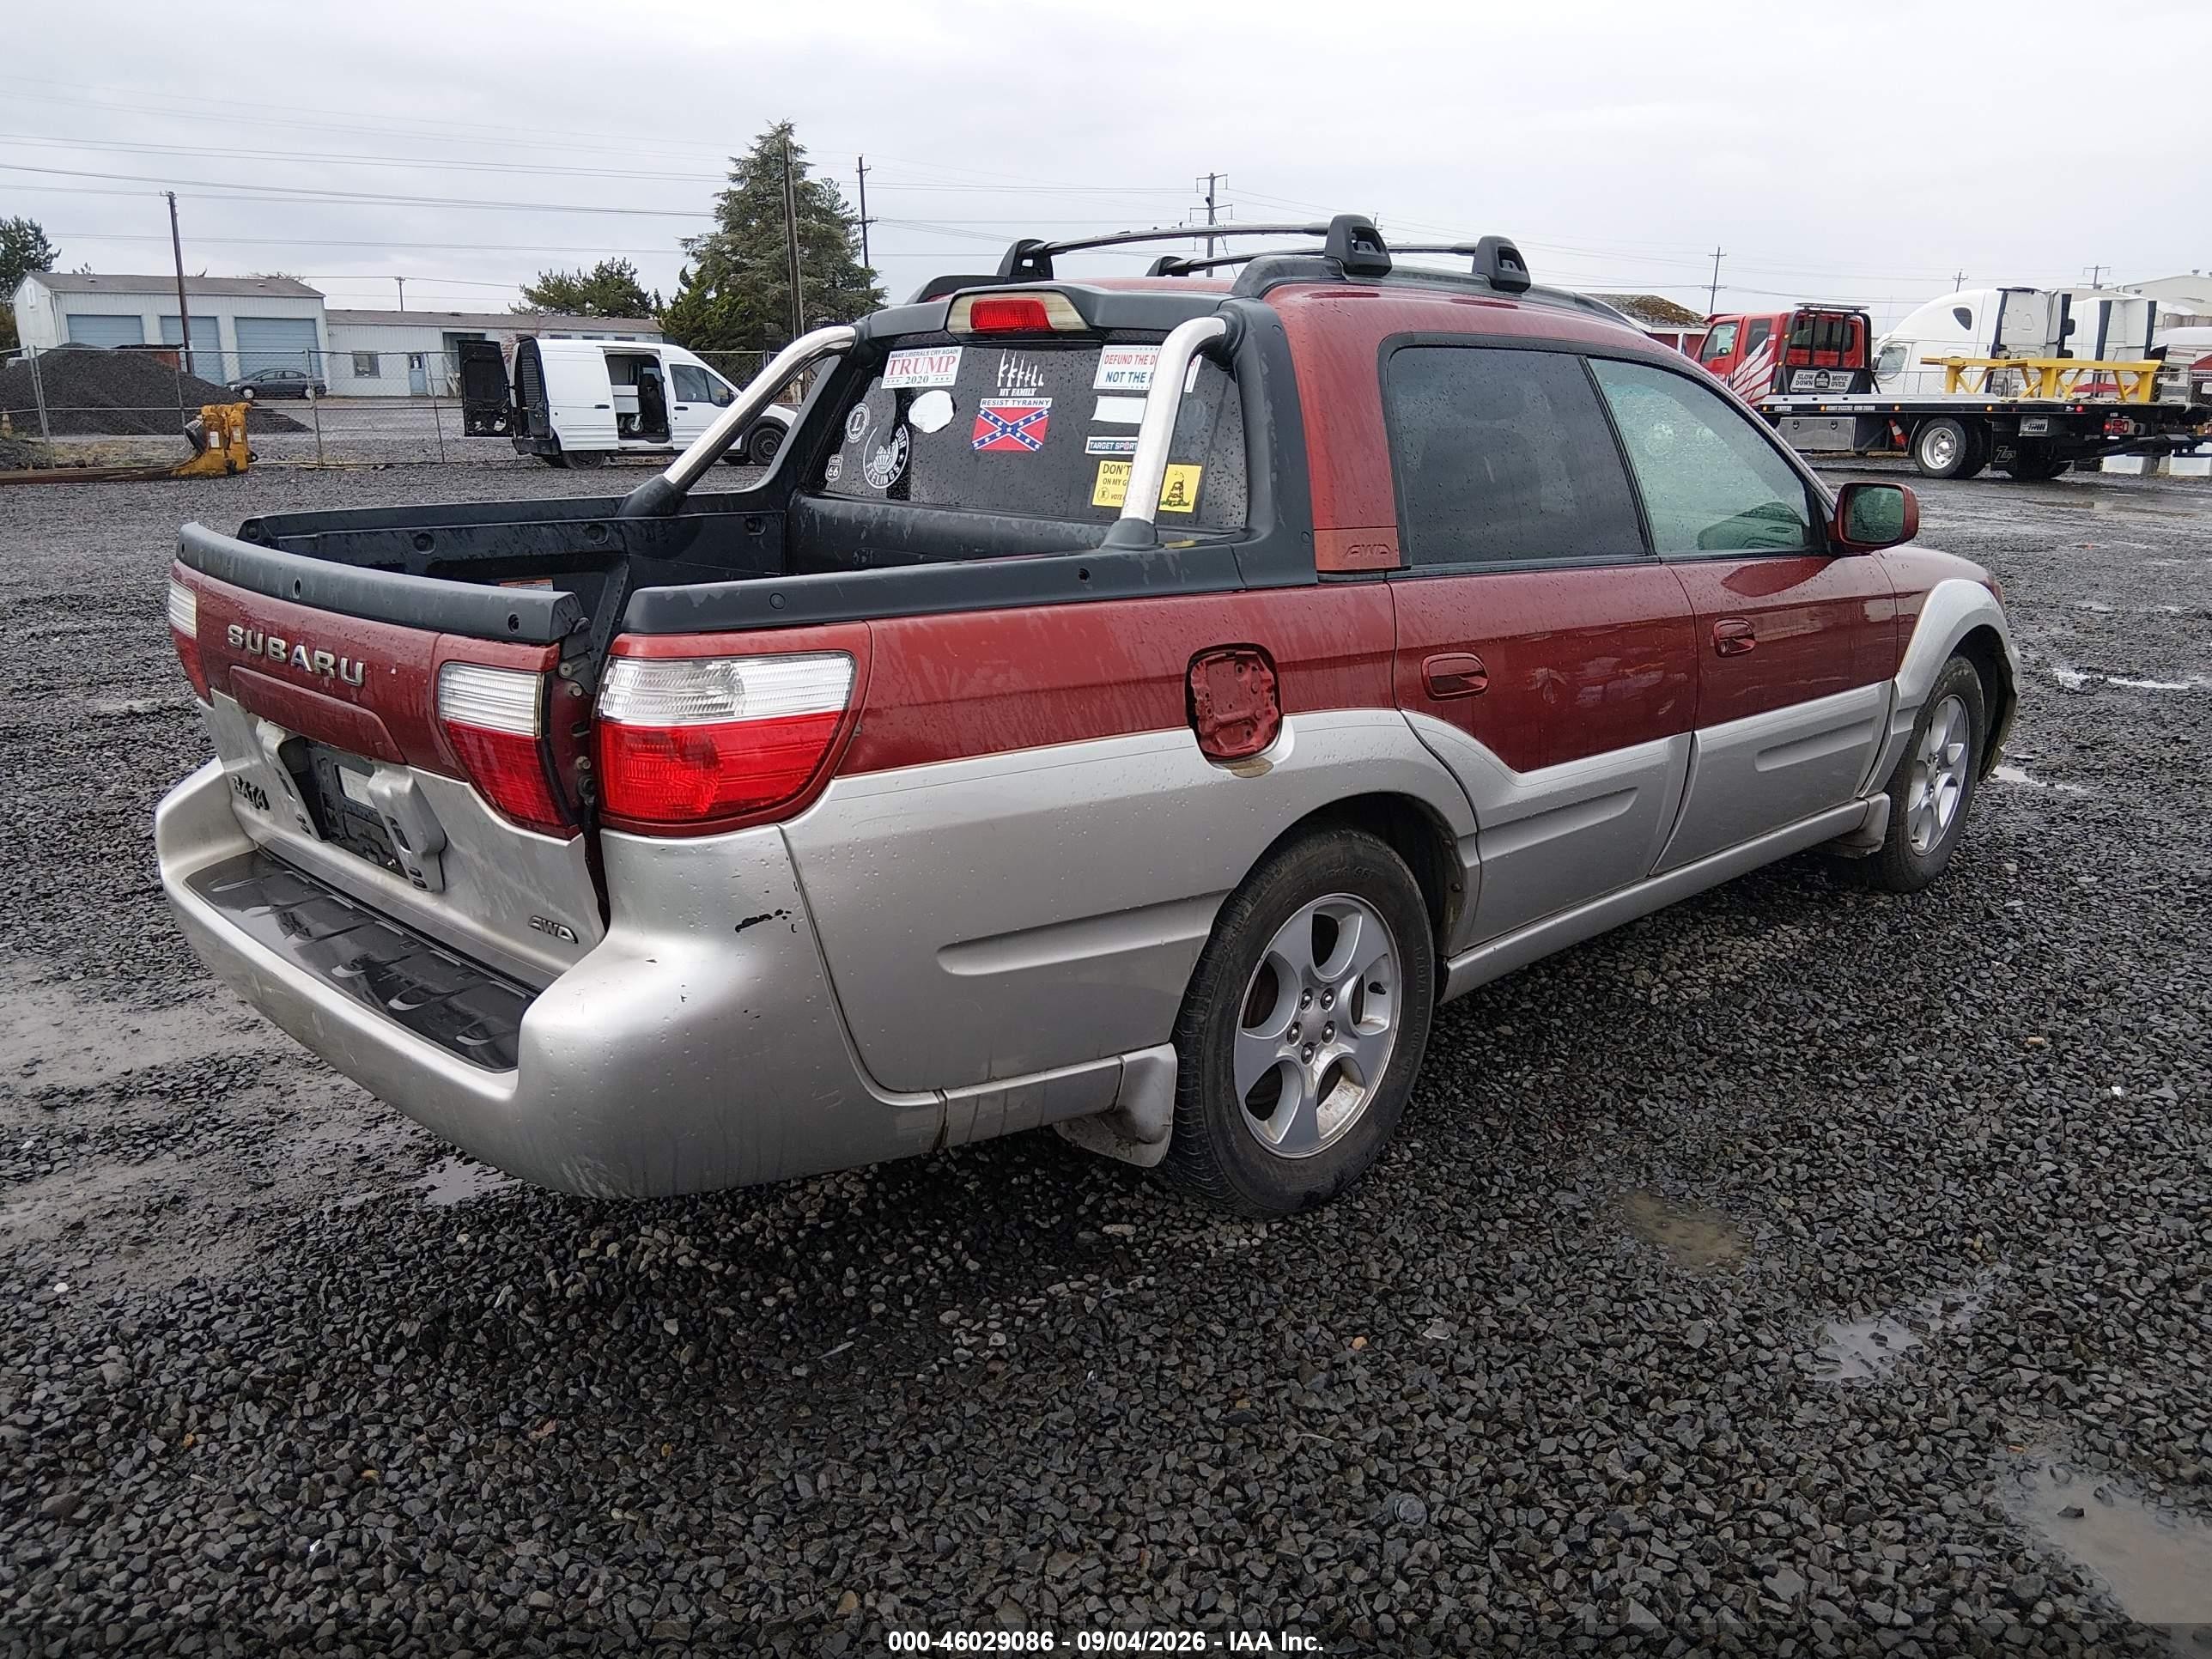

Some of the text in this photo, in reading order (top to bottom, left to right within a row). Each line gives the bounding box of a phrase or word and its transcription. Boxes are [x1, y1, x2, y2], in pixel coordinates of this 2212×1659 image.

[888, 356, 957, 376] TRUMP
[1103, 355, 1133, 365] DEFUND
[1133, 355, 1150, 365] THE
[904, 375, 929, 385] 2020
[1105, 371, 1126, 383] NOT
[1127, 371, 1147, 384] THE
[895, 427, 907, 449] OUR
[1090, 441, 1115, 450] TARGET
[828, 466, 839, 477] 66
[866, 462, 901, 485] FEELINGS
[1103, 464, 1133, 476] DON'T
[228, 623, 365, 687] SUBARU
